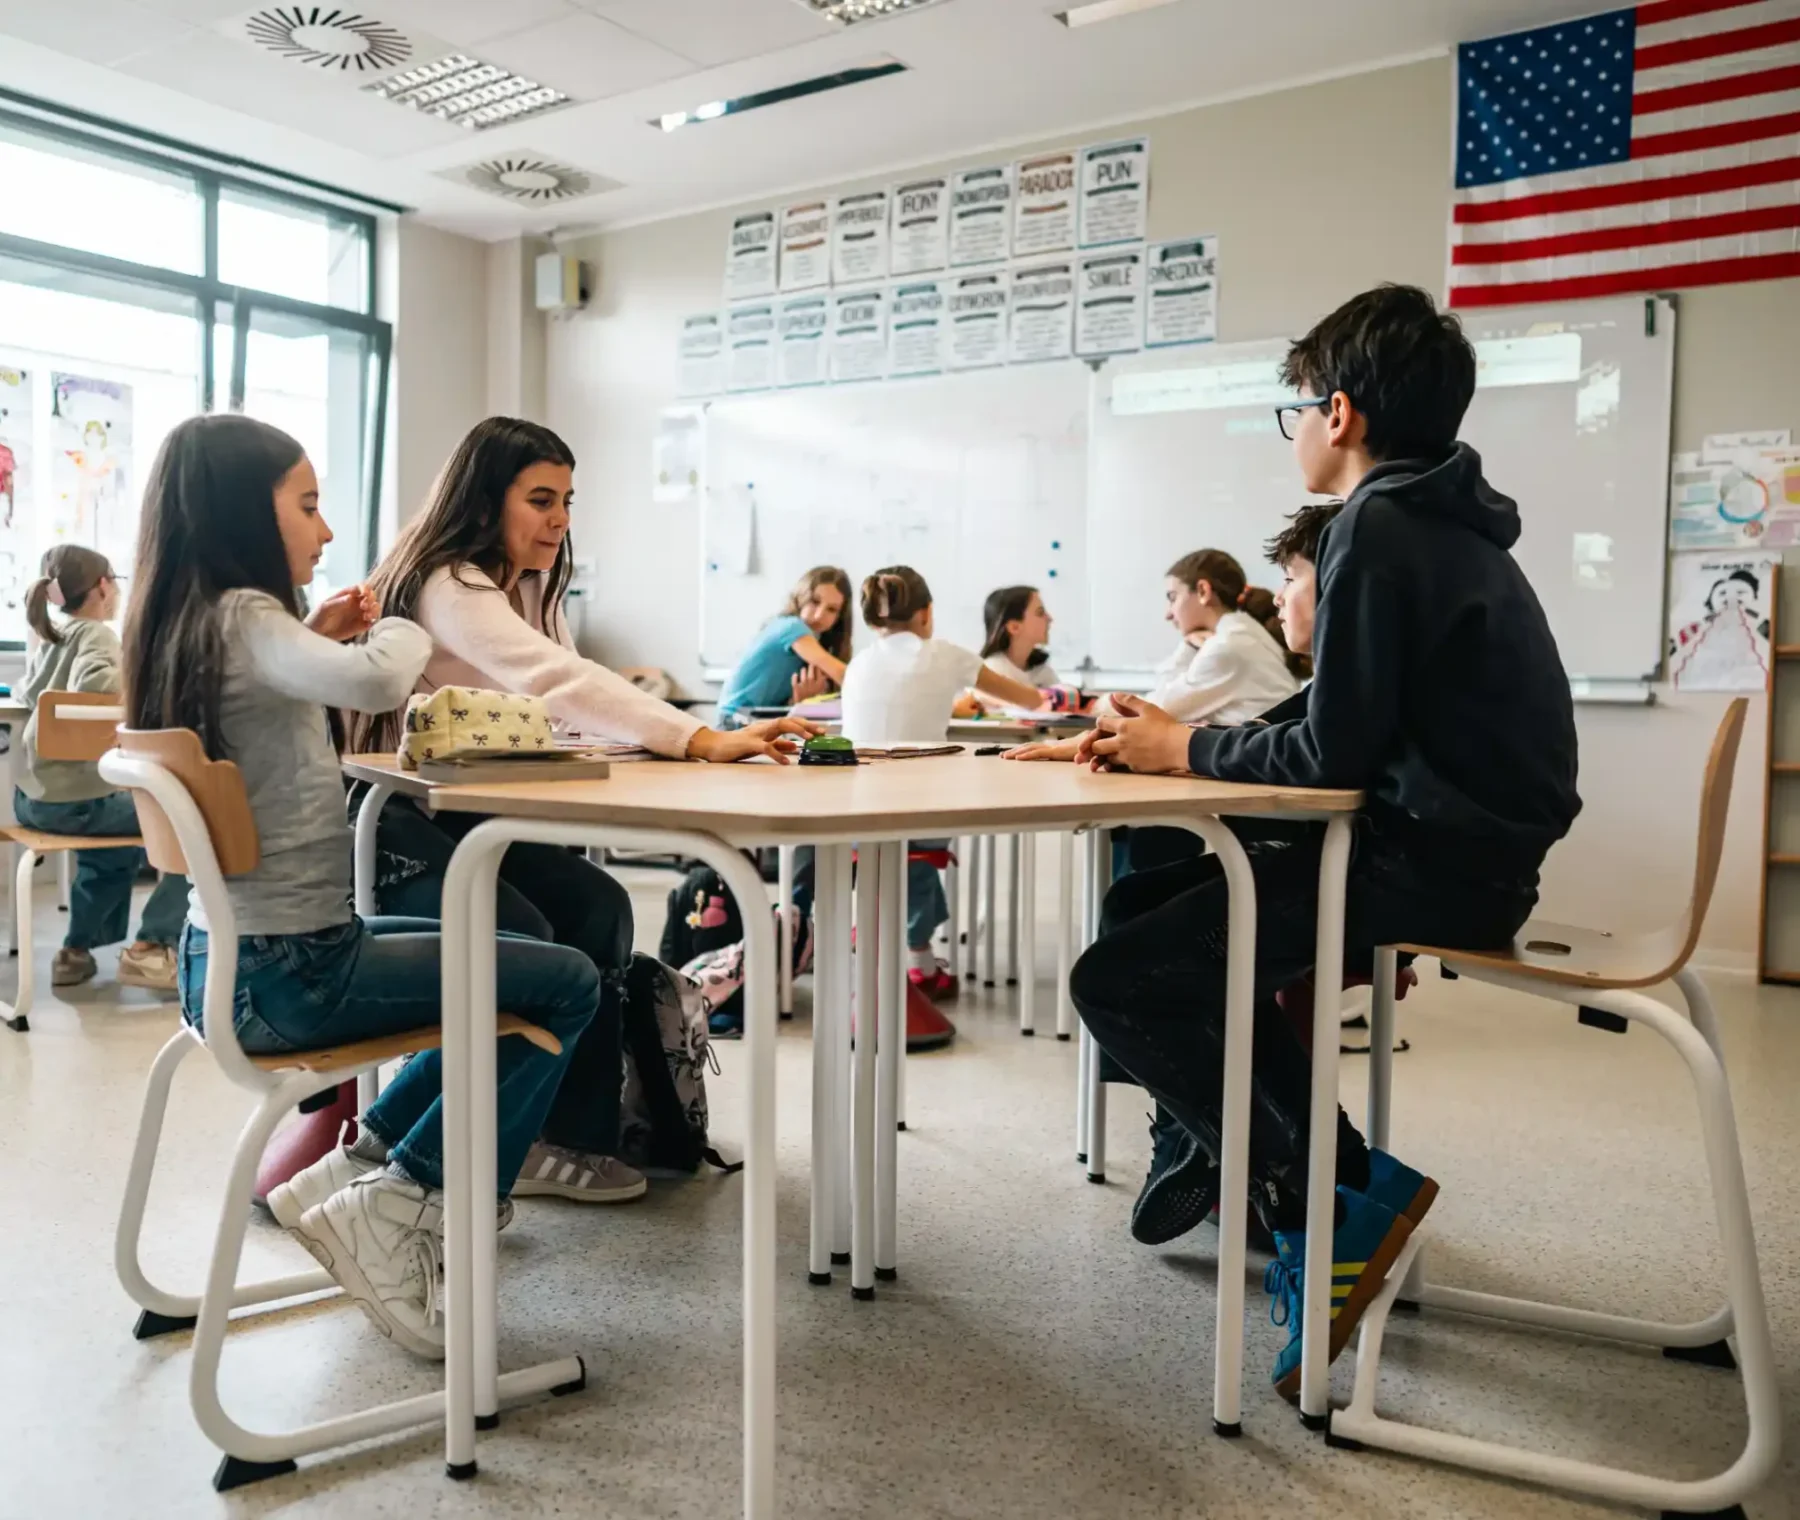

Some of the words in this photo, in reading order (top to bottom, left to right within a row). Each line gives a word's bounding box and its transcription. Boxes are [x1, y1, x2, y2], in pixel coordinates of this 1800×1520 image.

[1019, 169, 1075, 196] PARADOX
[1097, 160, 1132, 184] PUN
[1088, 267, 1132, 290] SIMILE
